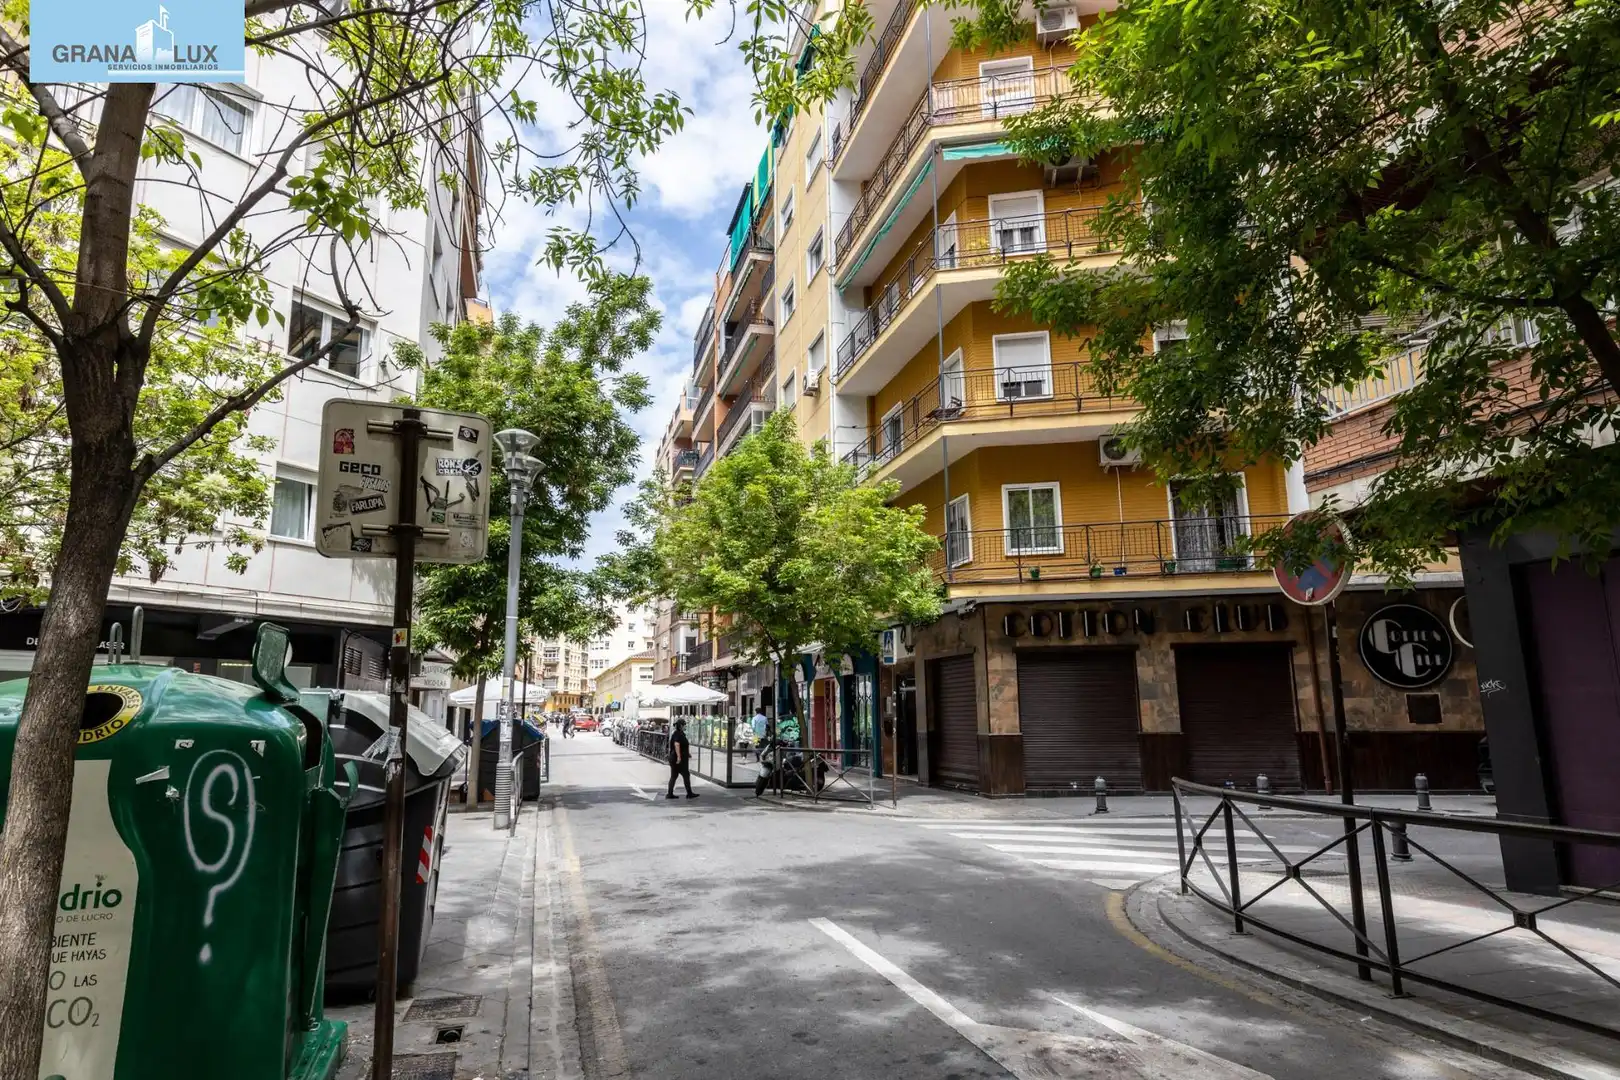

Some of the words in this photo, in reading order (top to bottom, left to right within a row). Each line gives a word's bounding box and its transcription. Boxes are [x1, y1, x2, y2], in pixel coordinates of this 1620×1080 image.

[350, 496, 384, 512] FARLOPA
[1002, 607, 1155, 639] COTTON
[1184, 602, 1289, 633] CLUB
[97, 641, 125, 649] ASER
[97, 685, 140, 709] ENVASES
[80, 719, 125, 742] DRIO
[60, 881, 122, 911] drio
[55, 915, 64, 924] O
[66, 914, 79, 923] DE
[81, 912, 114, 922] LUCRO
[51, 932, 97, 949] BIENTE
[51, 951, 67, 964] UE
[71, 948, 107, 962] HAYAS
[48, 970, 66, 991] O
[73, 974, 98, 988] LAS
